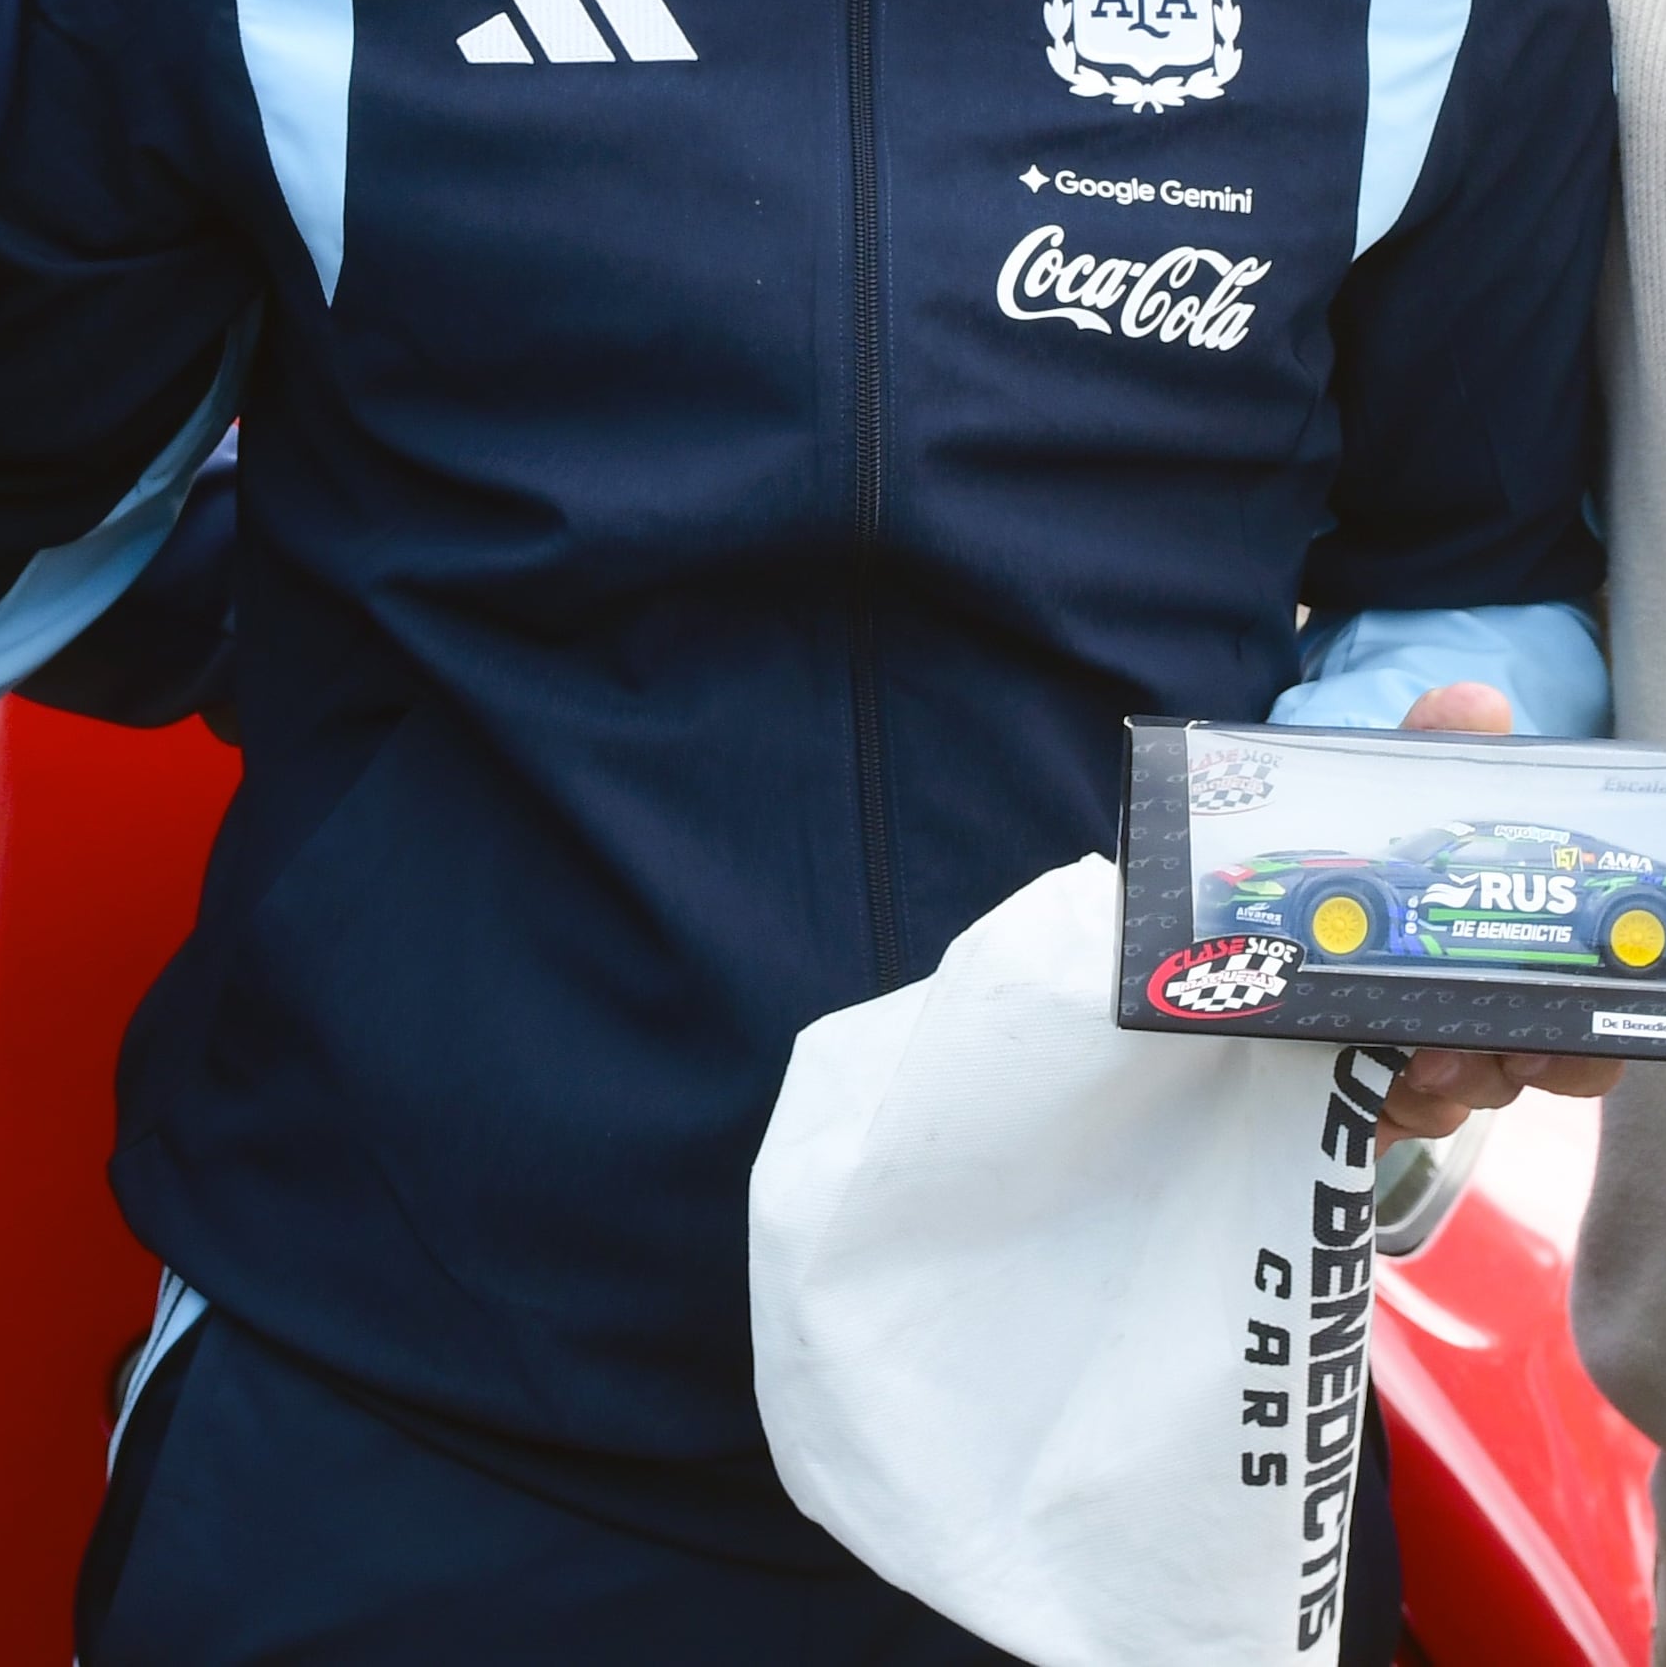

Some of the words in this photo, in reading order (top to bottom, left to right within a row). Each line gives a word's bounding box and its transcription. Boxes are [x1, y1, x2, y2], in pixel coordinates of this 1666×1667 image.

[1055, 171, 1155, 203] Google
[1160, 181, 1253, 214] Gemini
[996, 224, 1271, 351] Coca-Cola
[1598, 851, 1653, 870] AMA
[1480, 872, 1577, 914] RUS
[1236, 906, 1282, 922] Alvarez
[1452, 920, 1477, 937] DE
[1476, 921, 1572, 943] BENEDICTIS
[1173, 937, 1246, 969] CLASE
[1245, 937, 1298, 963] SLOT
[1602, 1018, 1619, 1029] De
[1241, 1247, 1292, 1487] CARS
[1297, 1180, 1374, 1652] BENEDICTIS
